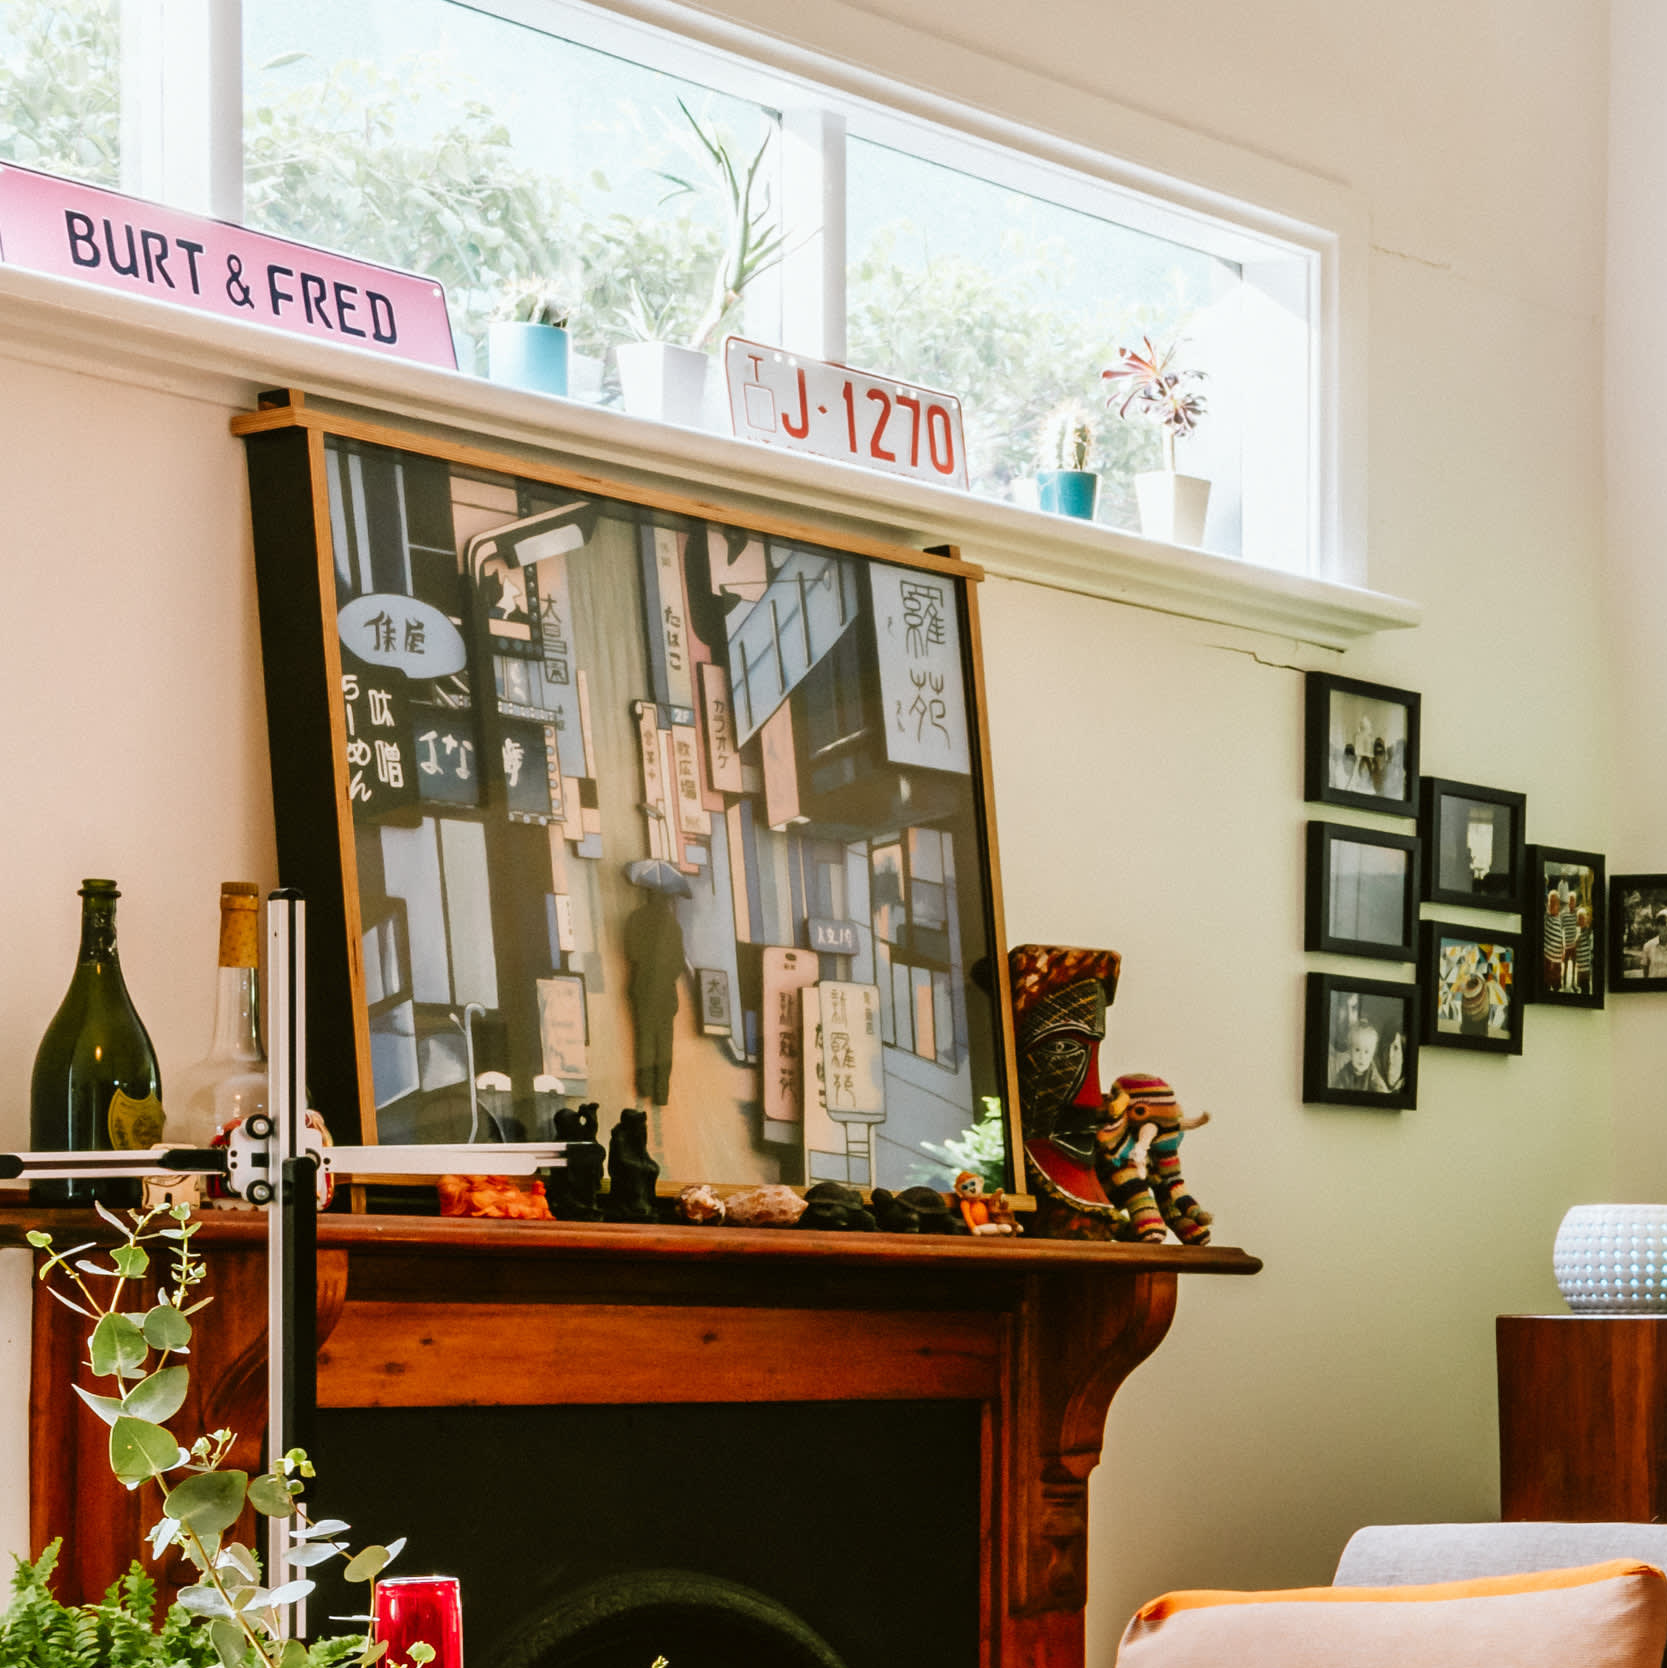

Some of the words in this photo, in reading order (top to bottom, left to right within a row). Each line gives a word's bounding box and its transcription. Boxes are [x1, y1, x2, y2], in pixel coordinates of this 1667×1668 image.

[64, 209, 205, 296] BURT
[225, 254, 255, 309] &
[266, 263, 399, 345] FRED
[747, 354, 764, 382] T
[367, 689, 404, 788] 味噌
[712, 700, 729, 769] カラオケ
